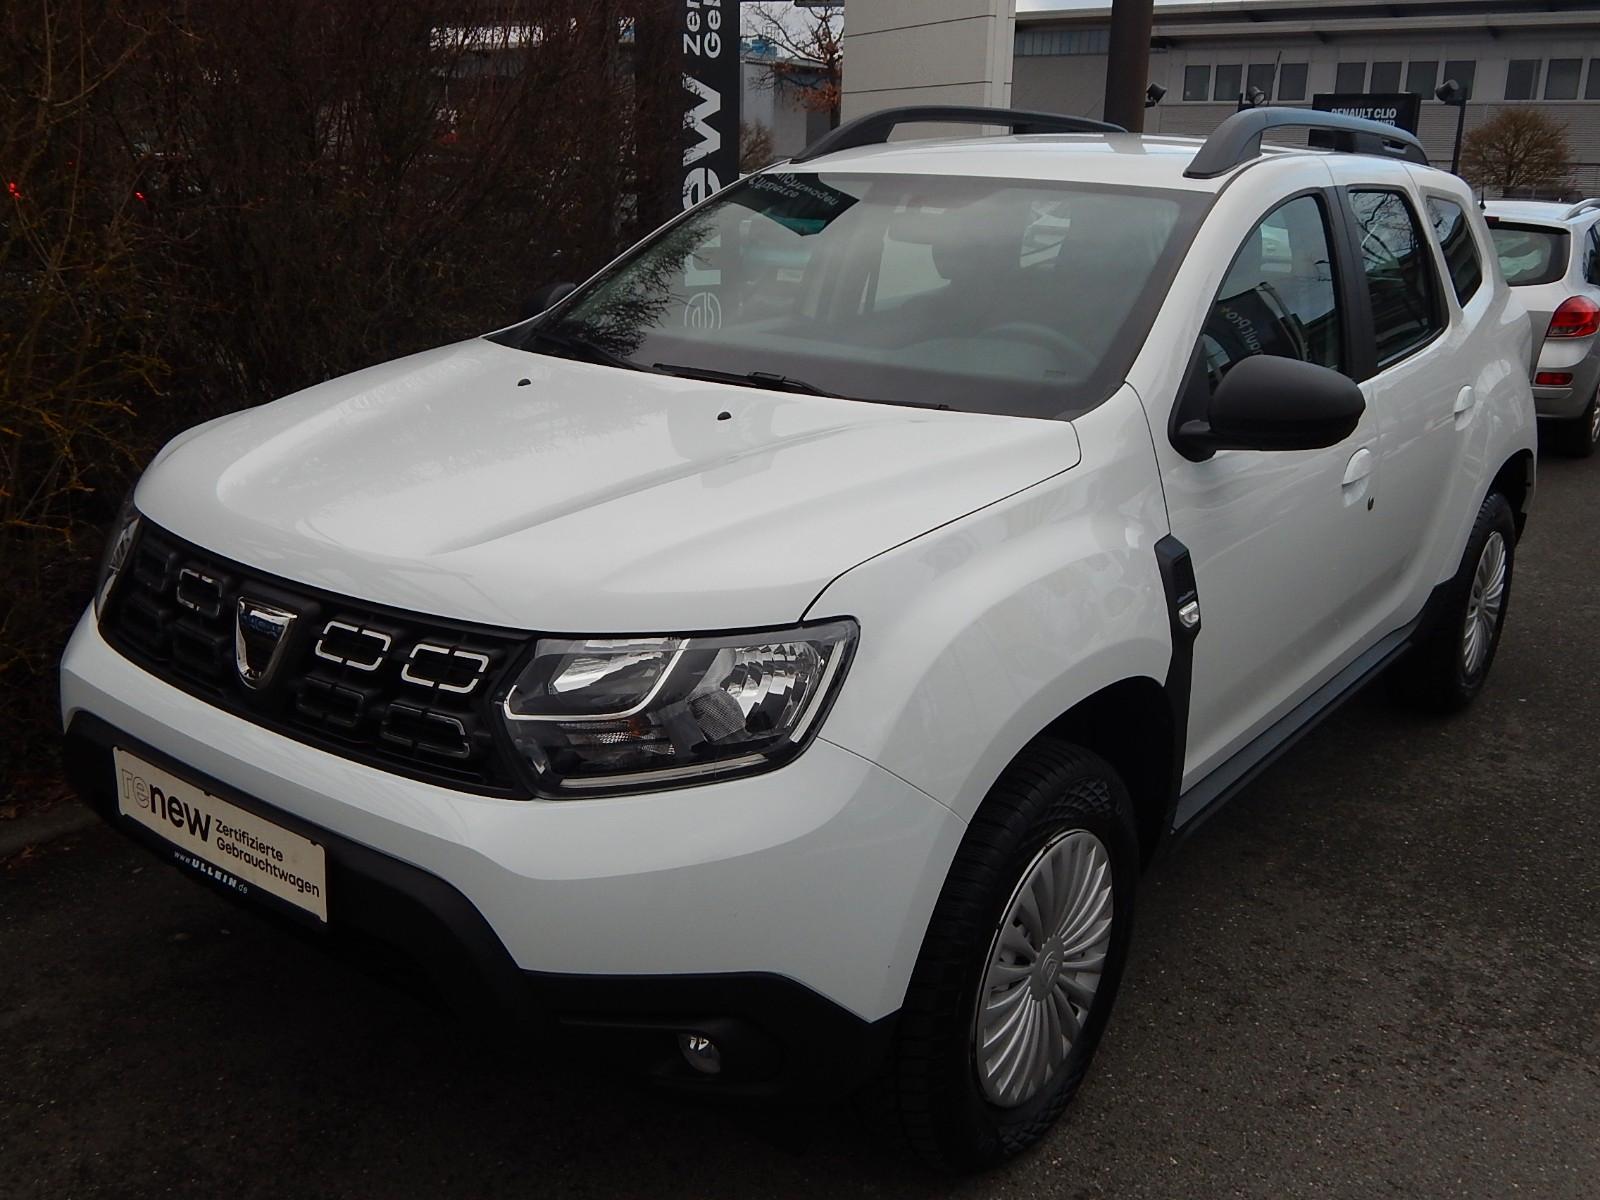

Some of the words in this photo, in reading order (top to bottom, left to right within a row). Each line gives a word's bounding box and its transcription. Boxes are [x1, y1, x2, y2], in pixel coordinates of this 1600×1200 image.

[1374, 107, 1397, 119] CLIO
[121, 768, 211, 842] renew
[216, 819, 283, 862] Zertifizierte
[216, 837, 320, 898] Gebrauchtwagen
